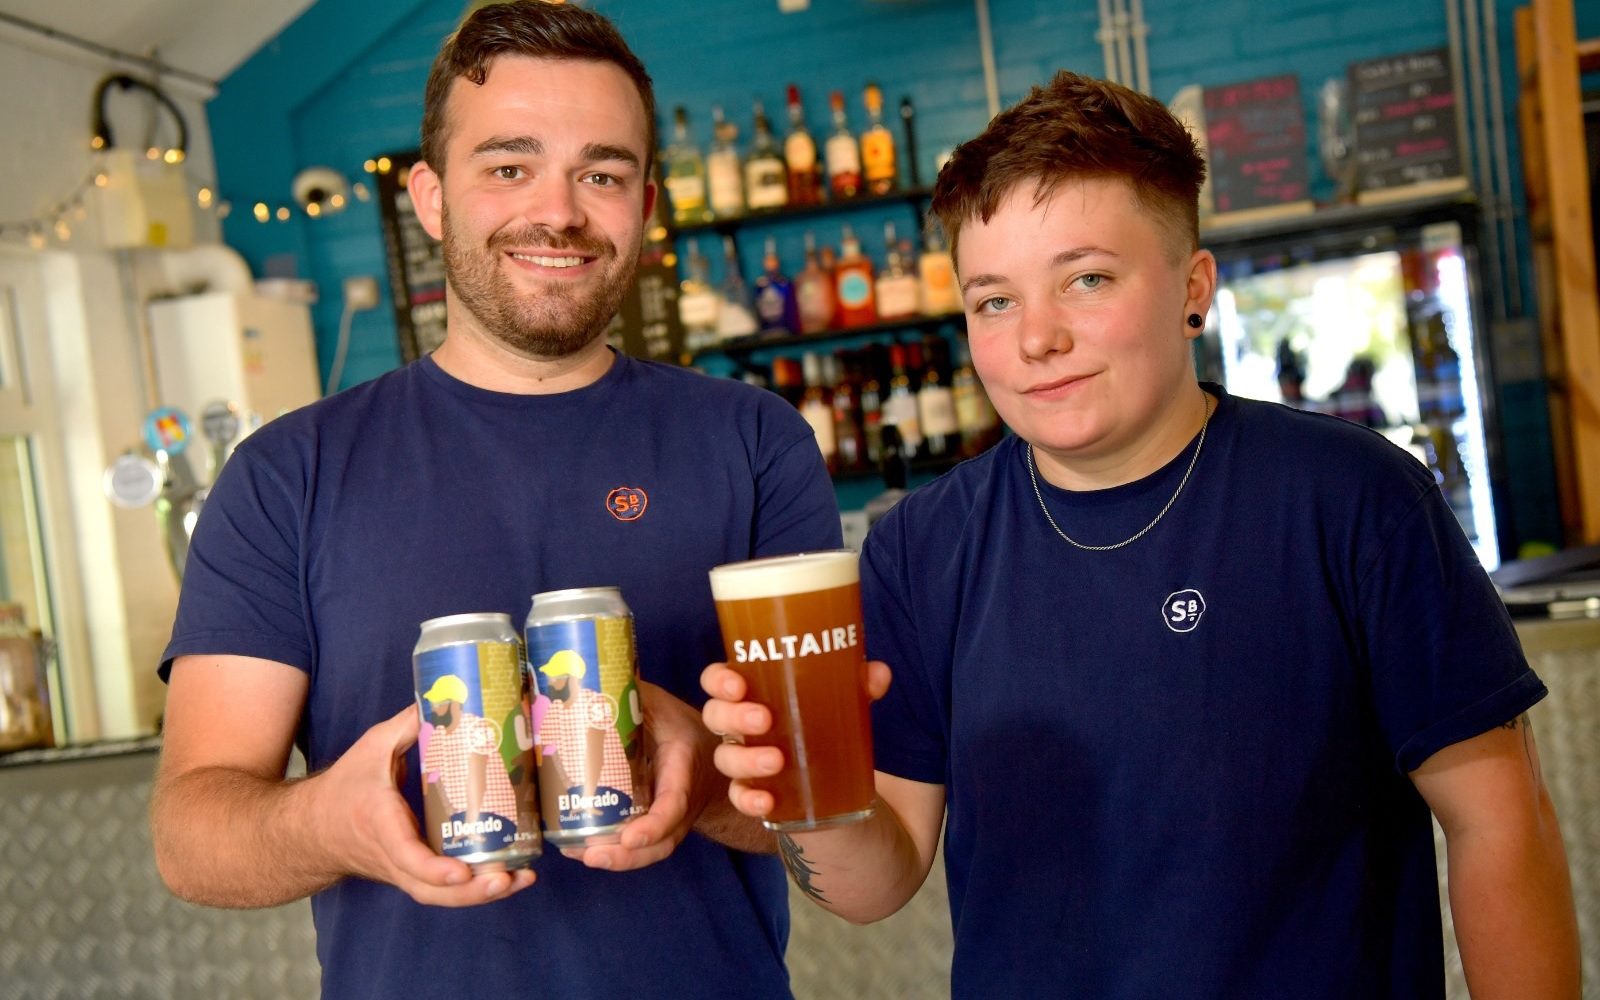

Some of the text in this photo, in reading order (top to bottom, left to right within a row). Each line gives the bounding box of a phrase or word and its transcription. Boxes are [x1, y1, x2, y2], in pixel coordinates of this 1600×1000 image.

[733, 624, 858, 663] SALTAIRE
[558, 790, 619, 811] El Dorado
[441, 816, 503, 838] El Dorado
